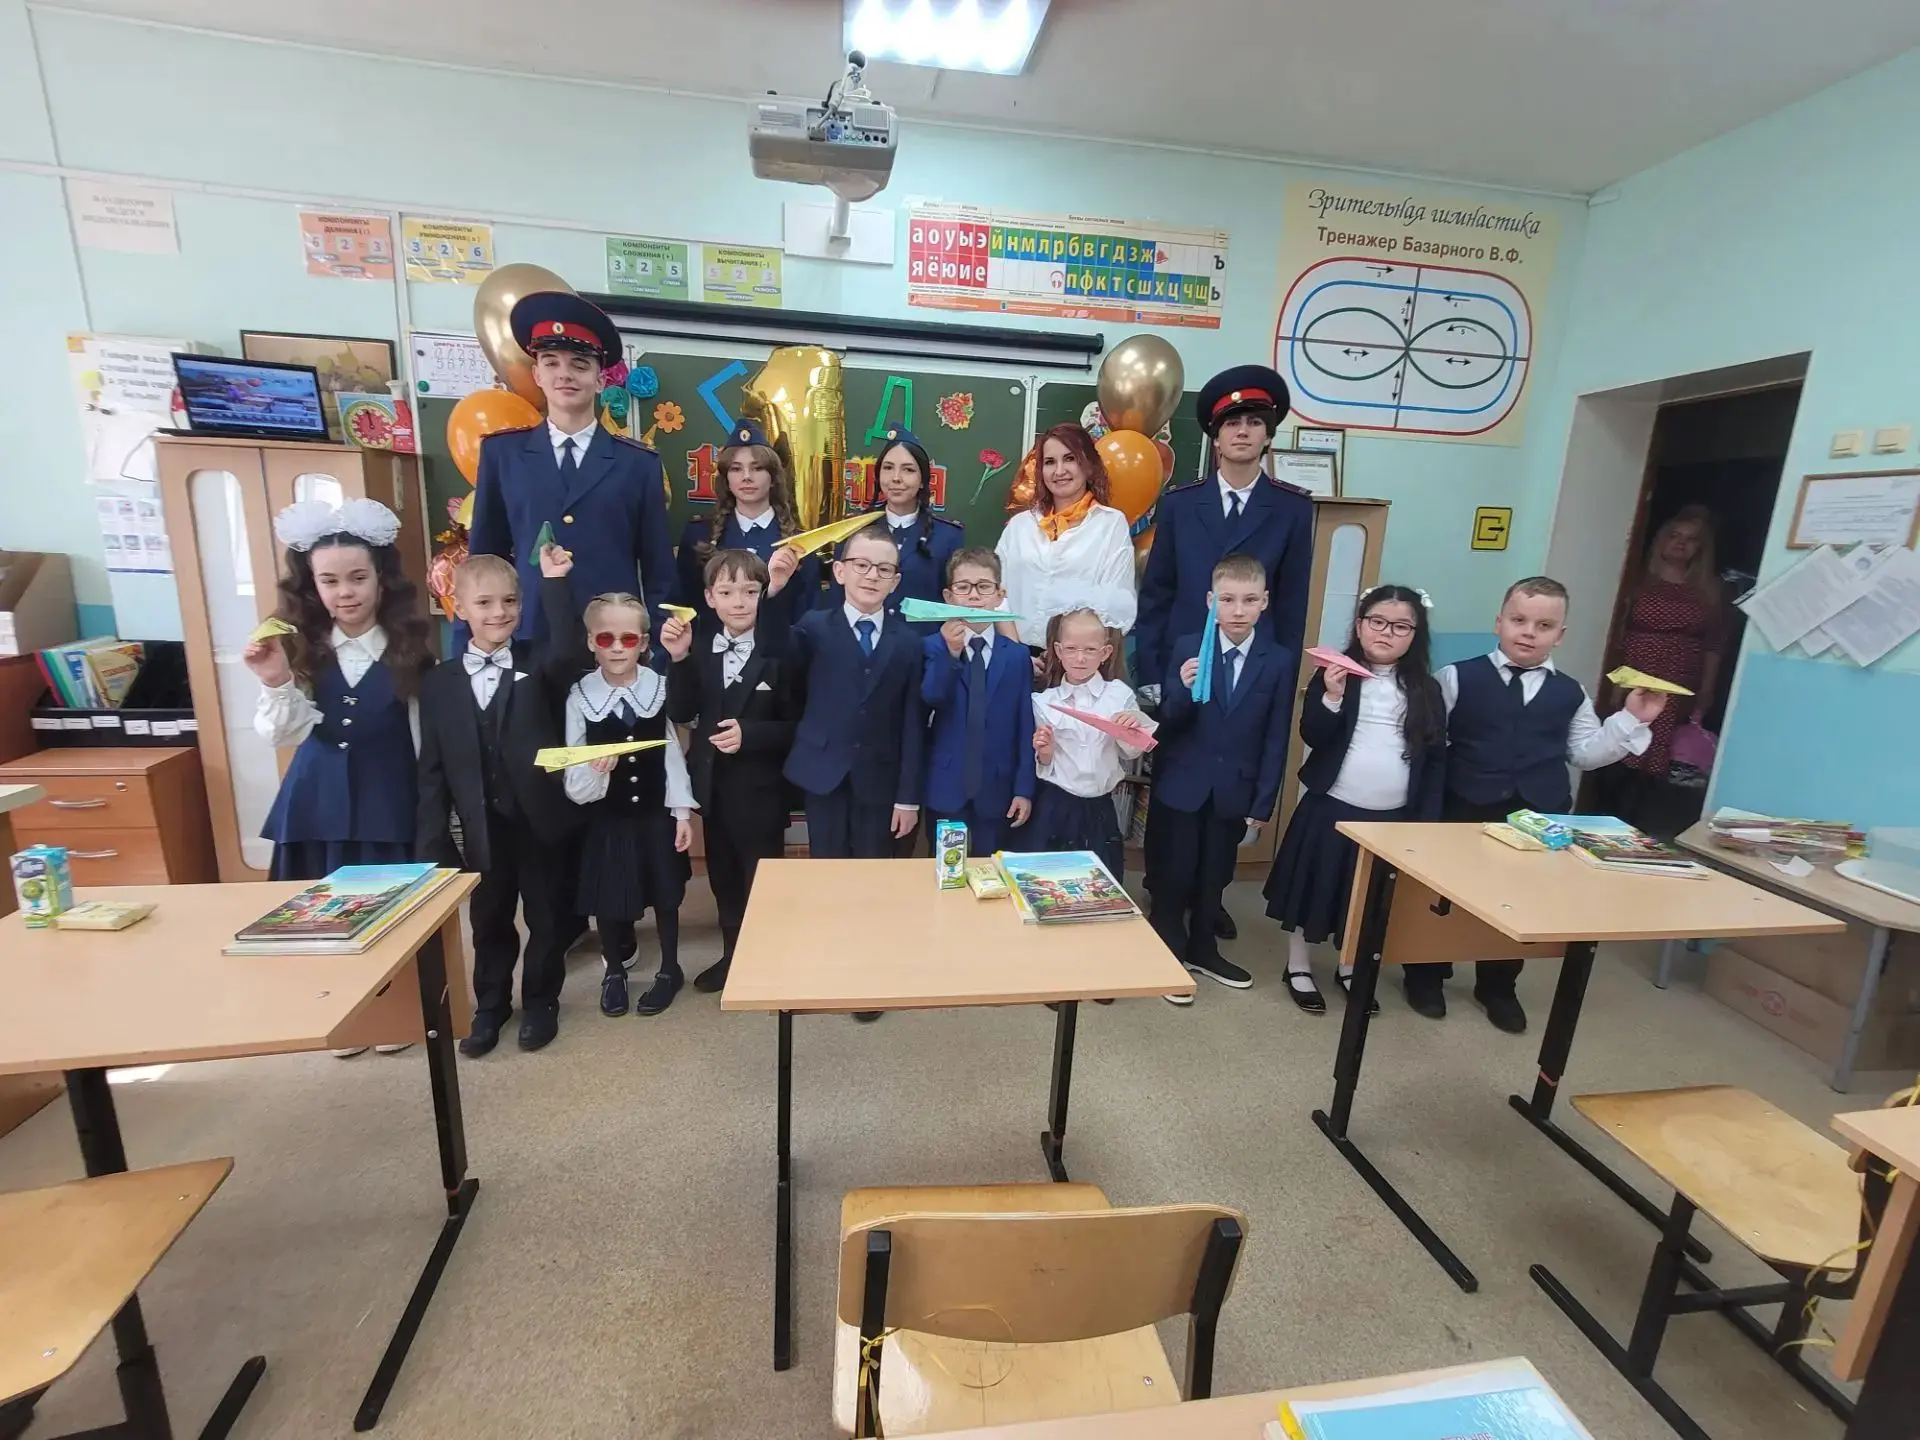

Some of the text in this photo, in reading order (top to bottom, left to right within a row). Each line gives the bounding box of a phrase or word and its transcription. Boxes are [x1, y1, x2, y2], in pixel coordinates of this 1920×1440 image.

[1308, 188, 1542, 240] Зрительная гимнастика
[341, 239, 350, 250] 2
[373, 240, 382, 252] 3
[411, 241, 420, 253] 3
[441, 244, 449, 255] 2
[473, 246, 482, 257] 6
[1317, 226, 1523, 264] Тренажер Базарного В.Ф.
[614, 260, 622, 271] 3
[640, 262, 649, 272] 2
[671, 265, 678, 276] 5
[735, 269, 744, 280] 2
[687, 443, 717, 505] 1
